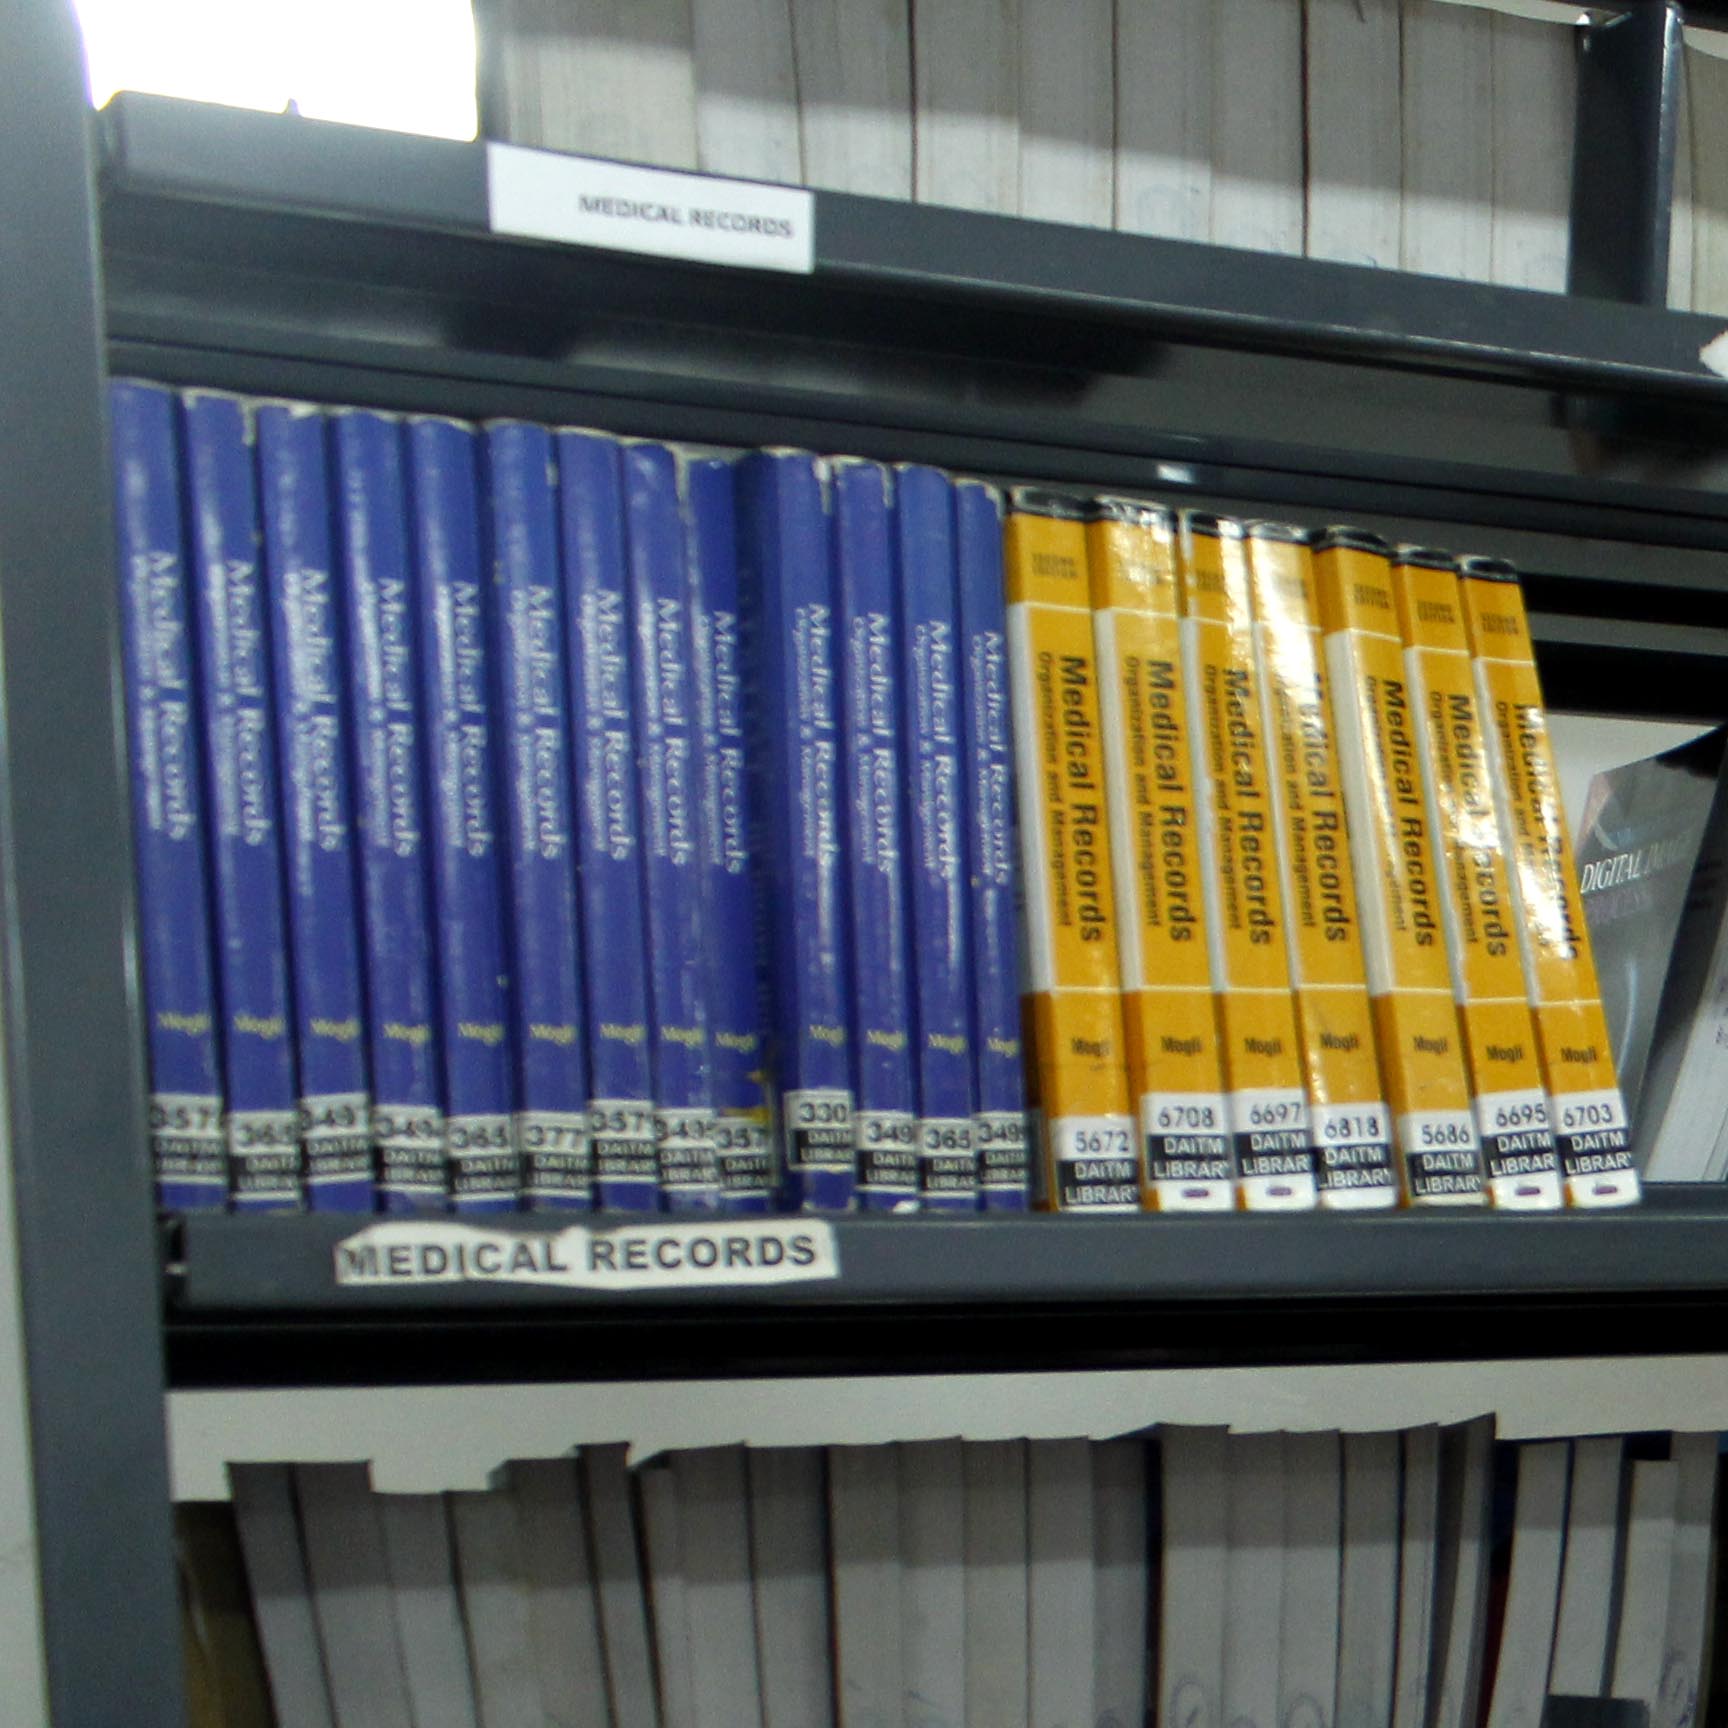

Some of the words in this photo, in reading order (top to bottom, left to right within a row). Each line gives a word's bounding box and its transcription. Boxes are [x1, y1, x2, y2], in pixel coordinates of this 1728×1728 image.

[578, 194, 682, 225] MEDICAL
[689, 208, 793, 238] RECORDS
[868, 612, 894, 737] Medical
[1060, 656, 1095, 789] Medical
[1148, 659, 1183, 791] Medical
[873, 749, 899, 873] Records
[1072, 803, 1106, 941] Records
[1159, 805, 1196, 941] Records
[1580, 850, 1641, 893] DIGITAL
[1159, 1105, 1213, 1127] 6708
[1324, 1117, 1378, 1137] 6818
[1422, 1124, 1470, 1144] 5686
[1495, 1104, 1546, 1125] 6695
[1563, 1103, 1613, 1124] 6703
[1075, 1130, 1130, 1151] 5672
[1074, 1161, 1131, 1180] DAITM
[343, 1239, 567, 1277] MEDICAL
[588, 1236, 815, 1269] RECORDS
